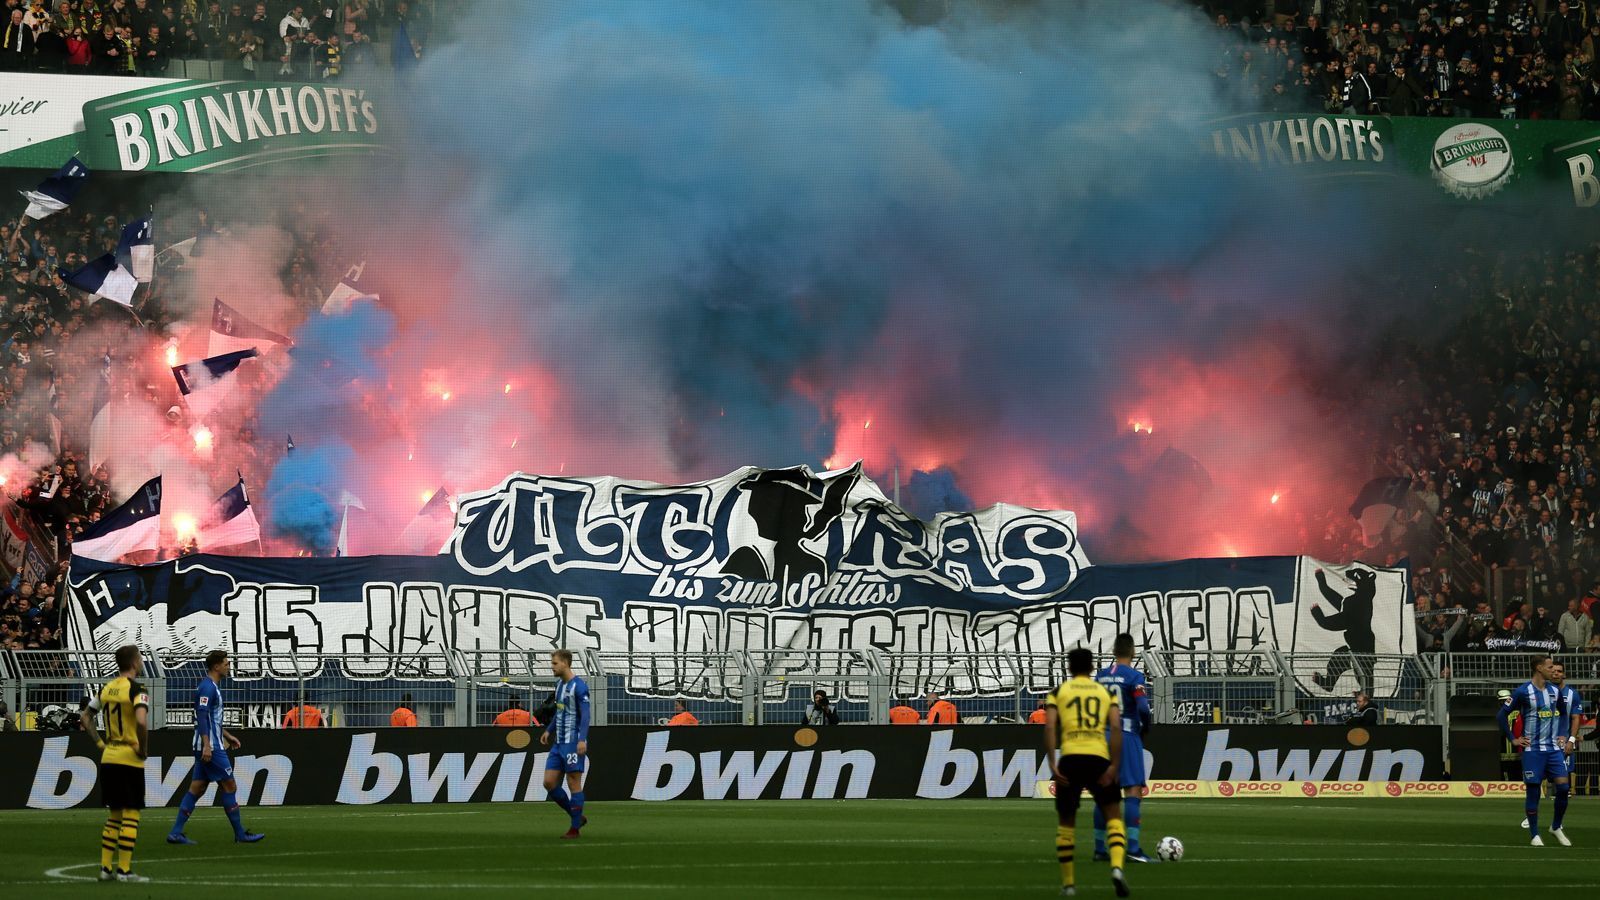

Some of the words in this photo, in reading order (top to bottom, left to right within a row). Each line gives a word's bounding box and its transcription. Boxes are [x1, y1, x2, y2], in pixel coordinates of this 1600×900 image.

[0, 96, 48, 117] vier
[111, 85, 378, 171] BRINKHOFF's
[1566, 149, 1600, 208] B
[85, 579, 115, 616] H
[649, 564, 704, 600] bis
[714, 577, 778, 606] zum
[222, 580, 326, 681] 15
[341, 581, 606, 692] JAHRE
[624, 585, 1276, 704] HAUPTSTADTMAFIA
[102, 701, 124, 738] 11
[1065, 695, 1101, 730] 19
[566, 753, 578, 765] 23
[630, 728, 877, 801] bwin
[1151, 782, 1198, 793] POCO
[1236, 782, 1283, 793] POCO
[1319, 782, 1365, 793] POCO
[1403, 782, 1450, 793] POCO
